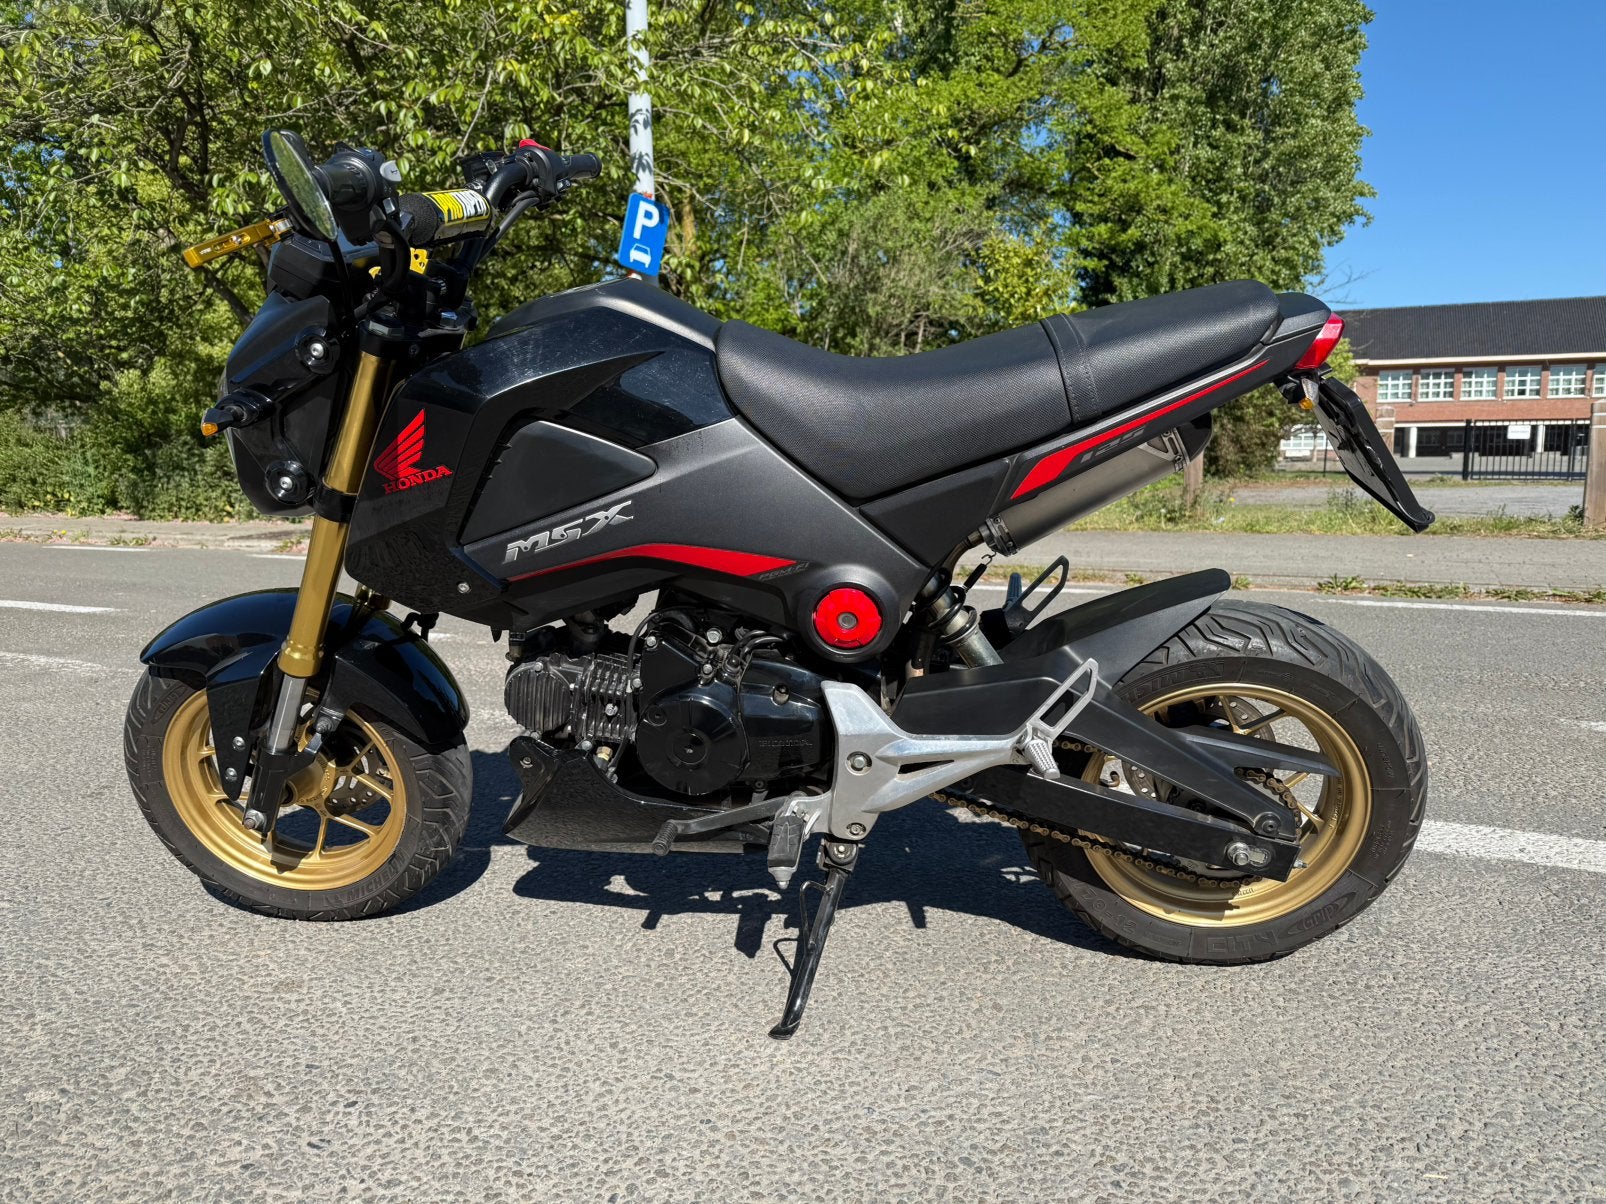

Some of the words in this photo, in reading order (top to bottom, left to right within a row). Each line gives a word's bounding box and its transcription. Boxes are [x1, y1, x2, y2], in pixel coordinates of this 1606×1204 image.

[633, 200, 660, 240] P
[382, 464, 454, 495] HONDA
[501, 500, 634, 566] MSX
